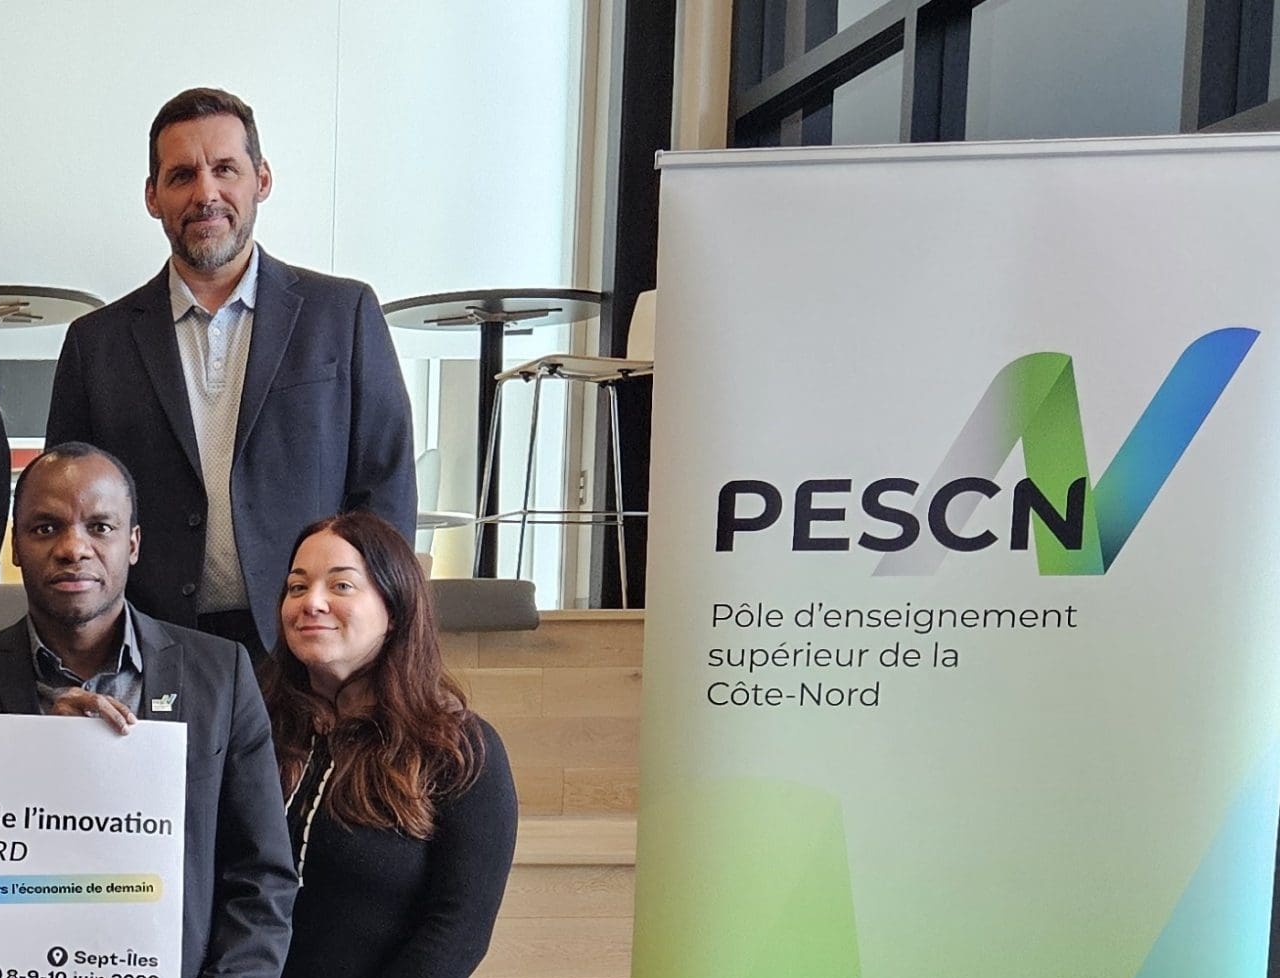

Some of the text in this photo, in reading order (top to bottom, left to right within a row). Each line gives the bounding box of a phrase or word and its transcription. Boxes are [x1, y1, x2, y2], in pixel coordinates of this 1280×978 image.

[715, 477, 1087, 552] PESCN
[712, 602, 1078, 634] Pôle d'enseignement
[708, 641, 959, 673] supérieur de la
[707, 681, 880, 707] Côte-Nord
[24, 806, 173, 835] l'innovation
[12, 883, 83, 895] l'économie
[86, 882, 103, 894] de
[106, 881, 154, 894] demain
[73, 948, 159, 969] Sept-Îles
